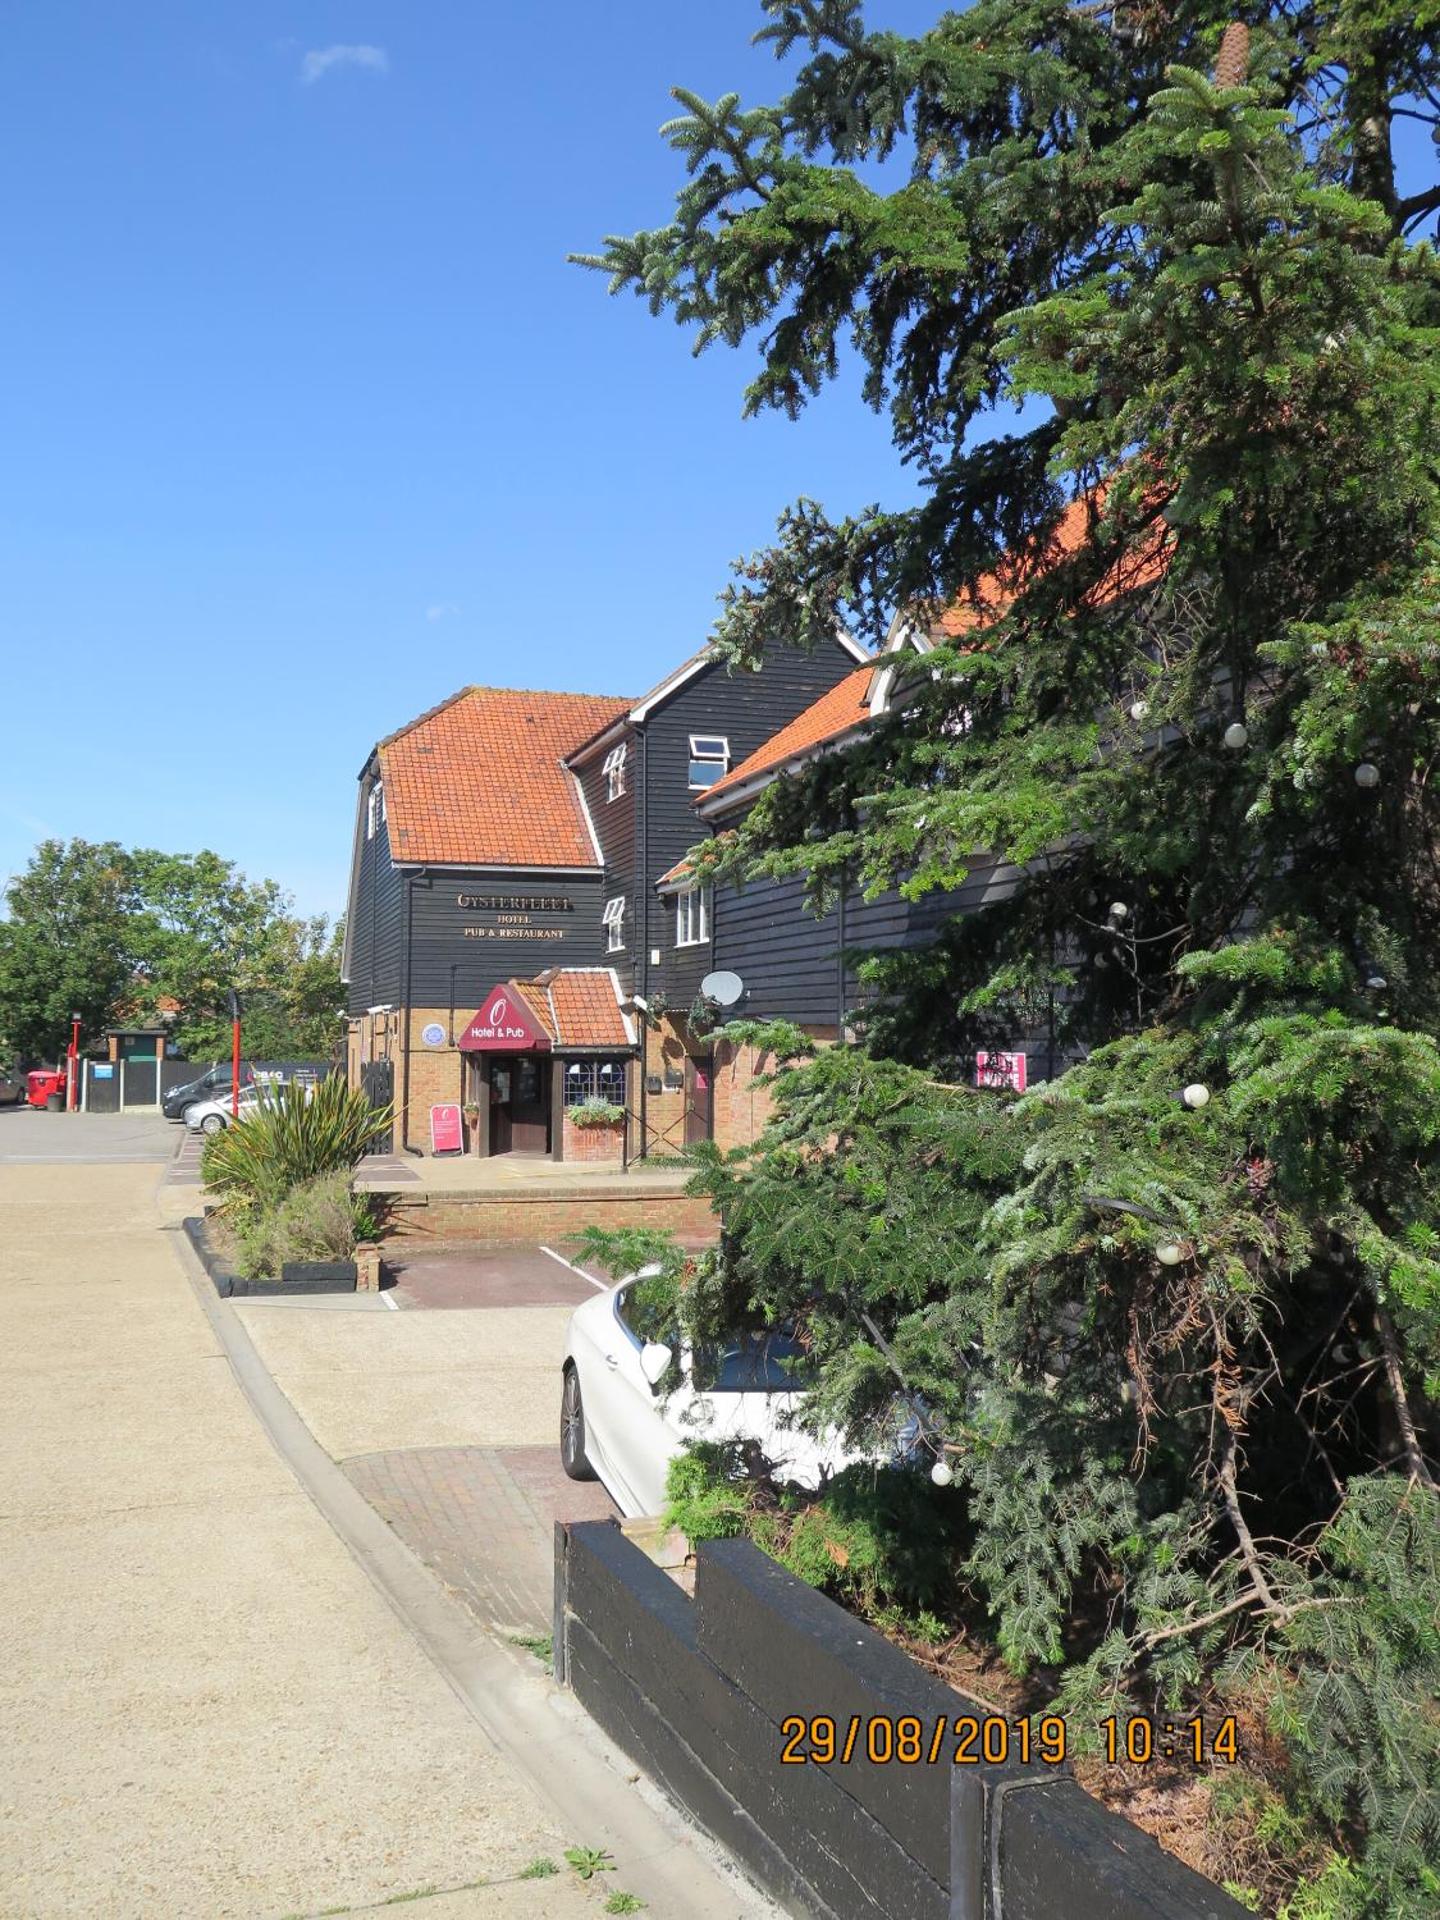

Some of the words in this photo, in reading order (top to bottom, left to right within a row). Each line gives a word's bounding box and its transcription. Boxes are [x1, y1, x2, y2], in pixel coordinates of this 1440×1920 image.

[497, 914, 531, 924] HOTEL
[464, 927, 485, 937] PUB
[488, 928, 495, 937] &
[499, 928, 563, 938] RESTAURANT
[471, 1027, 495, 1038] Hotel
[497, 1027, 504, 1038] &
[506, 1027, 525, 1038] Pub
